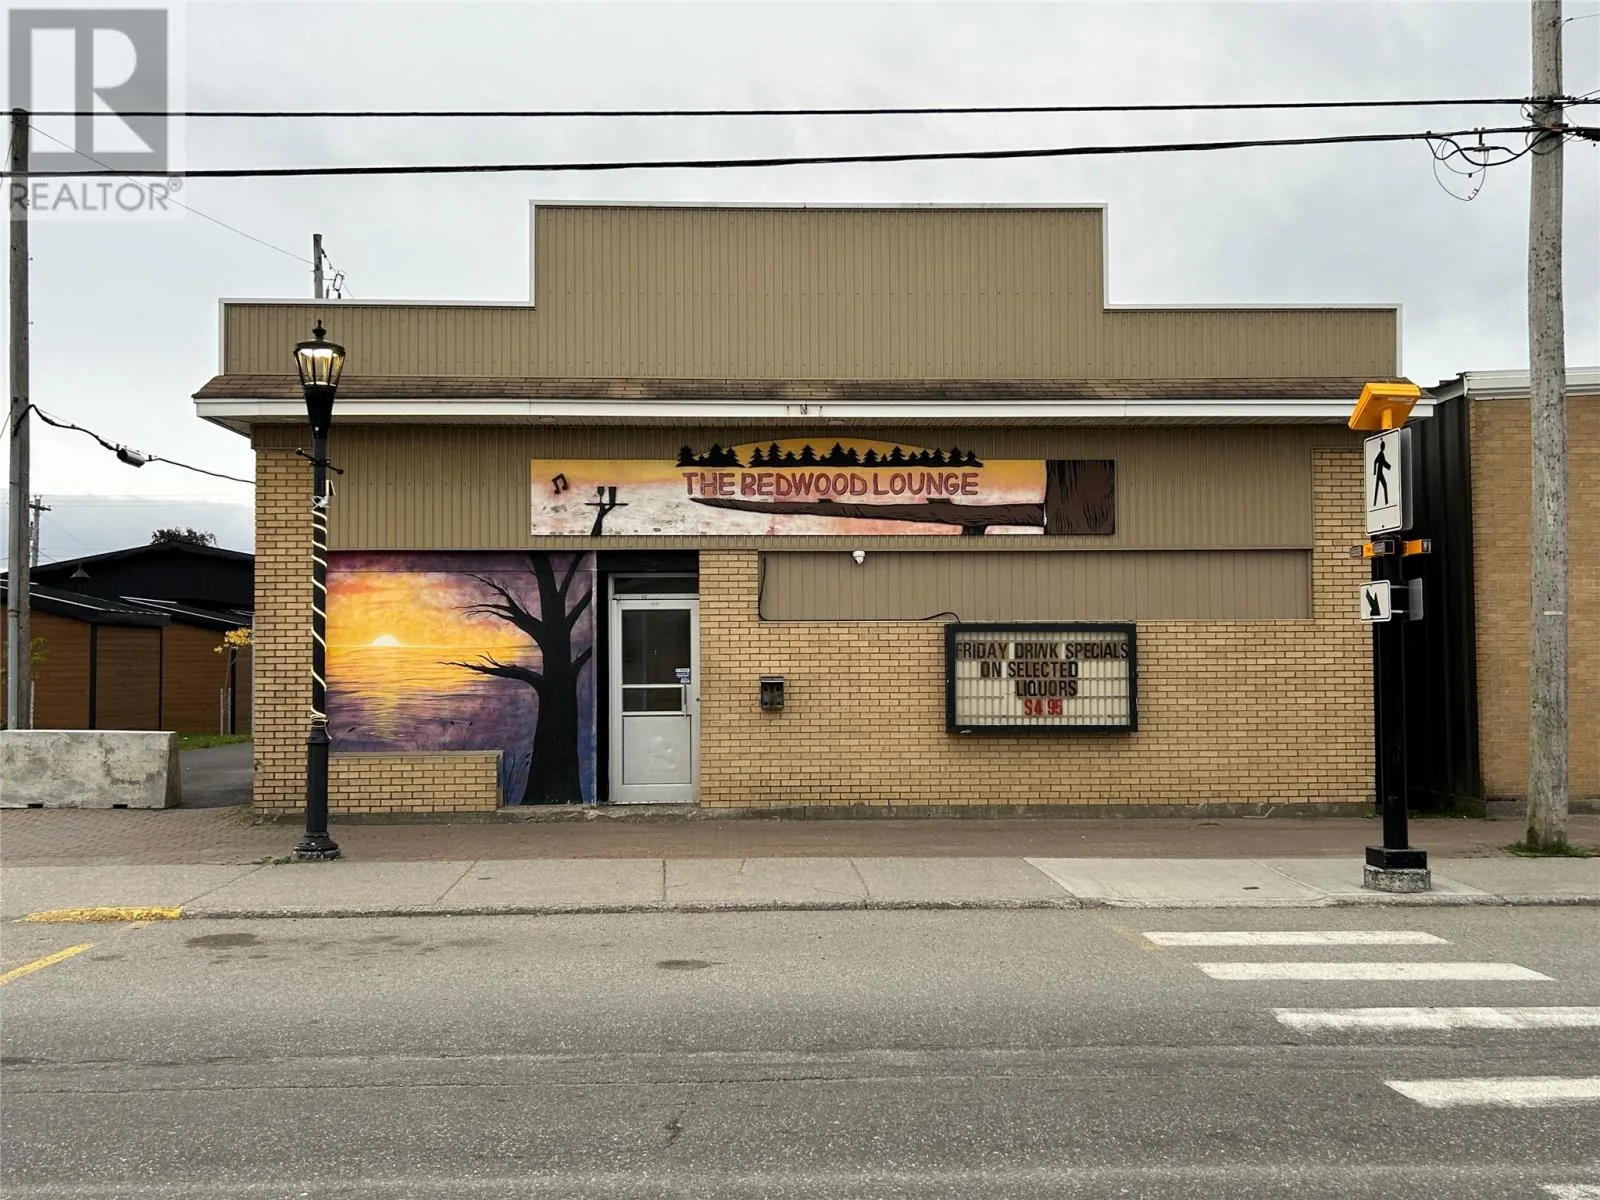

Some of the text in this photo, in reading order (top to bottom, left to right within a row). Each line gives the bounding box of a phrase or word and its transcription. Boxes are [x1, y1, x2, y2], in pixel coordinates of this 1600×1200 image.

[682, 472, 979, 496] THE REDWOOD LOUNGE
[956, 642, 1129, 659] FRIDAY DRINK SPECIALS
[980, 661, 1078, 678] ON SELECTED
[1016, 680, 1078, 697] LIQUORS
